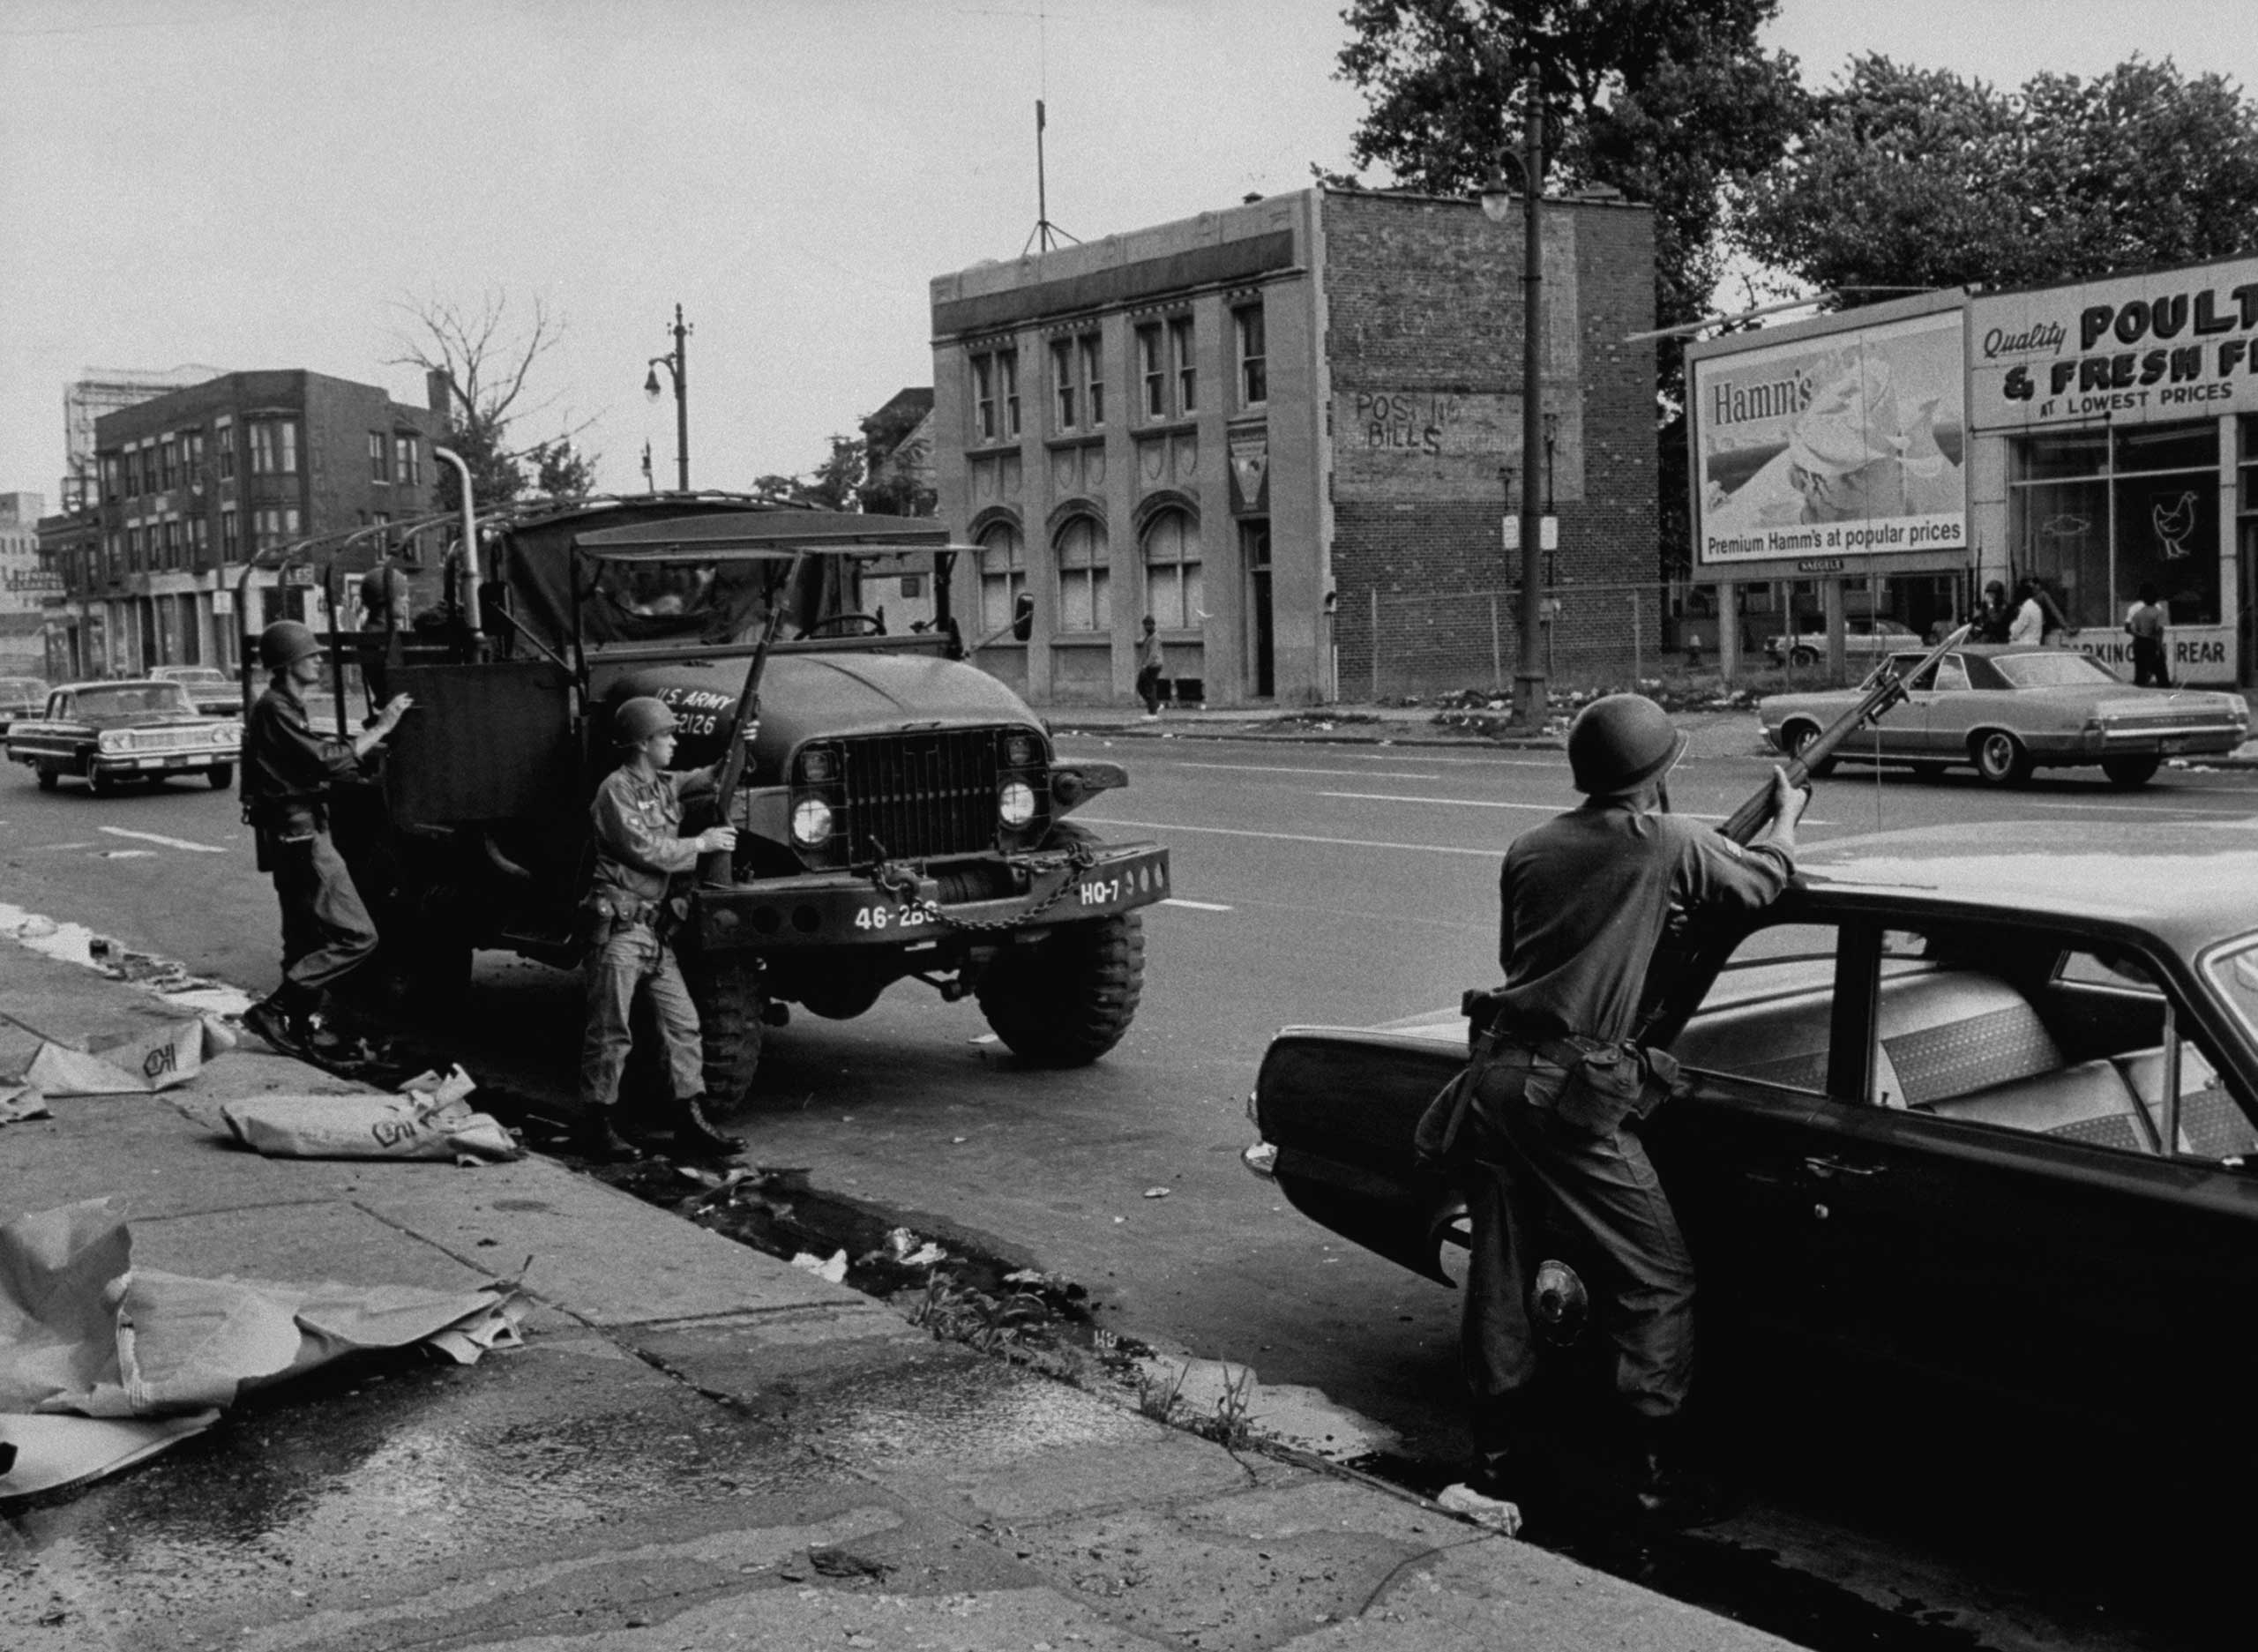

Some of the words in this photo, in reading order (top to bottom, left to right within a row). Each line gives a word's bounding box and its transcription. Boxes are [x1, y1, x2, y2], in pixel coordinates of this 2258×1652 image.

[1984, 321, 2067, 359] Quality
[2003, 365, 2035, 401] &
[2050, 345, 2202, 396] FRESH
[1714, 369, 1813, 426] Hamm's
[2039, 400, 2056, 419] AT
[2067, 391, 2150, 415] LOWEST
[2160, 382, 2233, 406] PRICES
[1368, 421, 1442, 457] BILLS
[1708, 534, 1764, 556] Premium
[1768, 529, 1822, 551] Hamm's
[1827, 528, 1842, 548] at
[1845, 523, 1903, 550] popular
[1909, 520, 1962, 547] prices
[2176, 641, 2225, 663] REAR
[682, 691, 736, 711] ARMY
